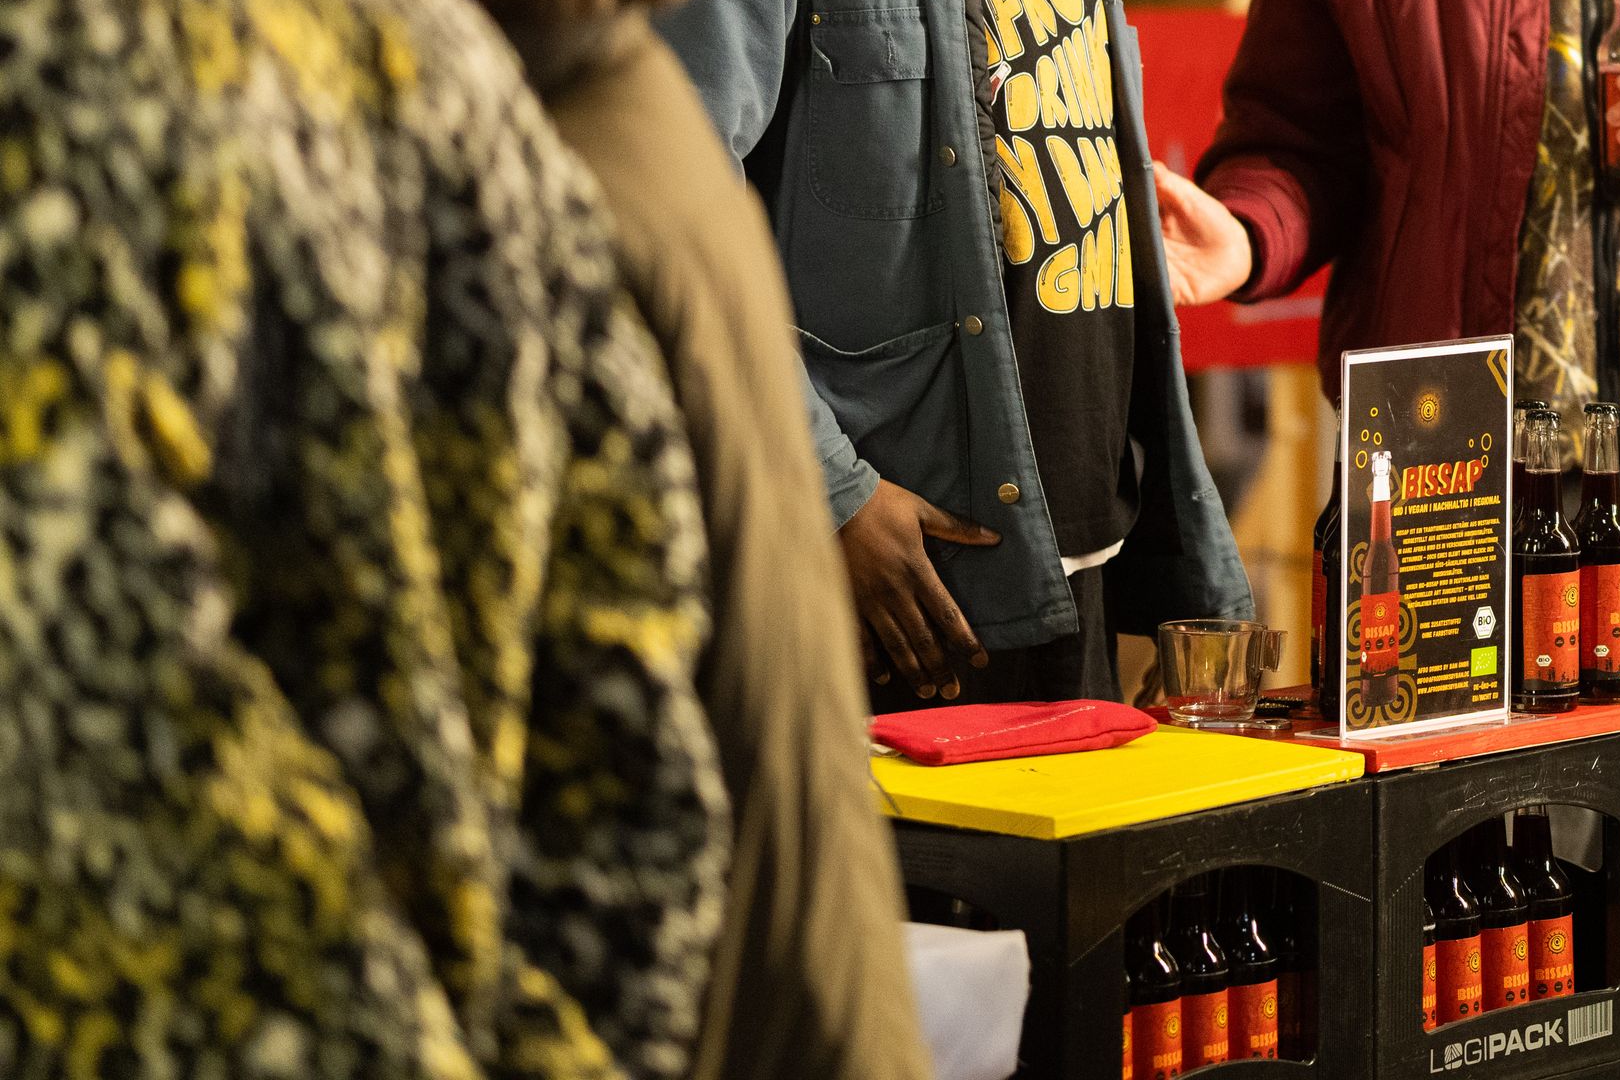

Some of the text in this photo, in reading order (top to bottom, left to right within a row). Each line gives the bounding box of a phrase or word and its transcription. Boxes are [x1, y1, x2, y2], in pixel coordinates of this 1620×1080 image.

[1401, 458, 1483, 501] BISSAP
[1394, 506, 1403, 516] BIO
[1408, 503, 1428, 515] VEGAN
[1432, 499, 1468, 512] NACHHALTIG
[1473, 496, 1501, 508] REGIONAL
[1365, 624, 1395, 639] BISSAP
[1430, 1018, 1563, 1074] LOGIPACK
